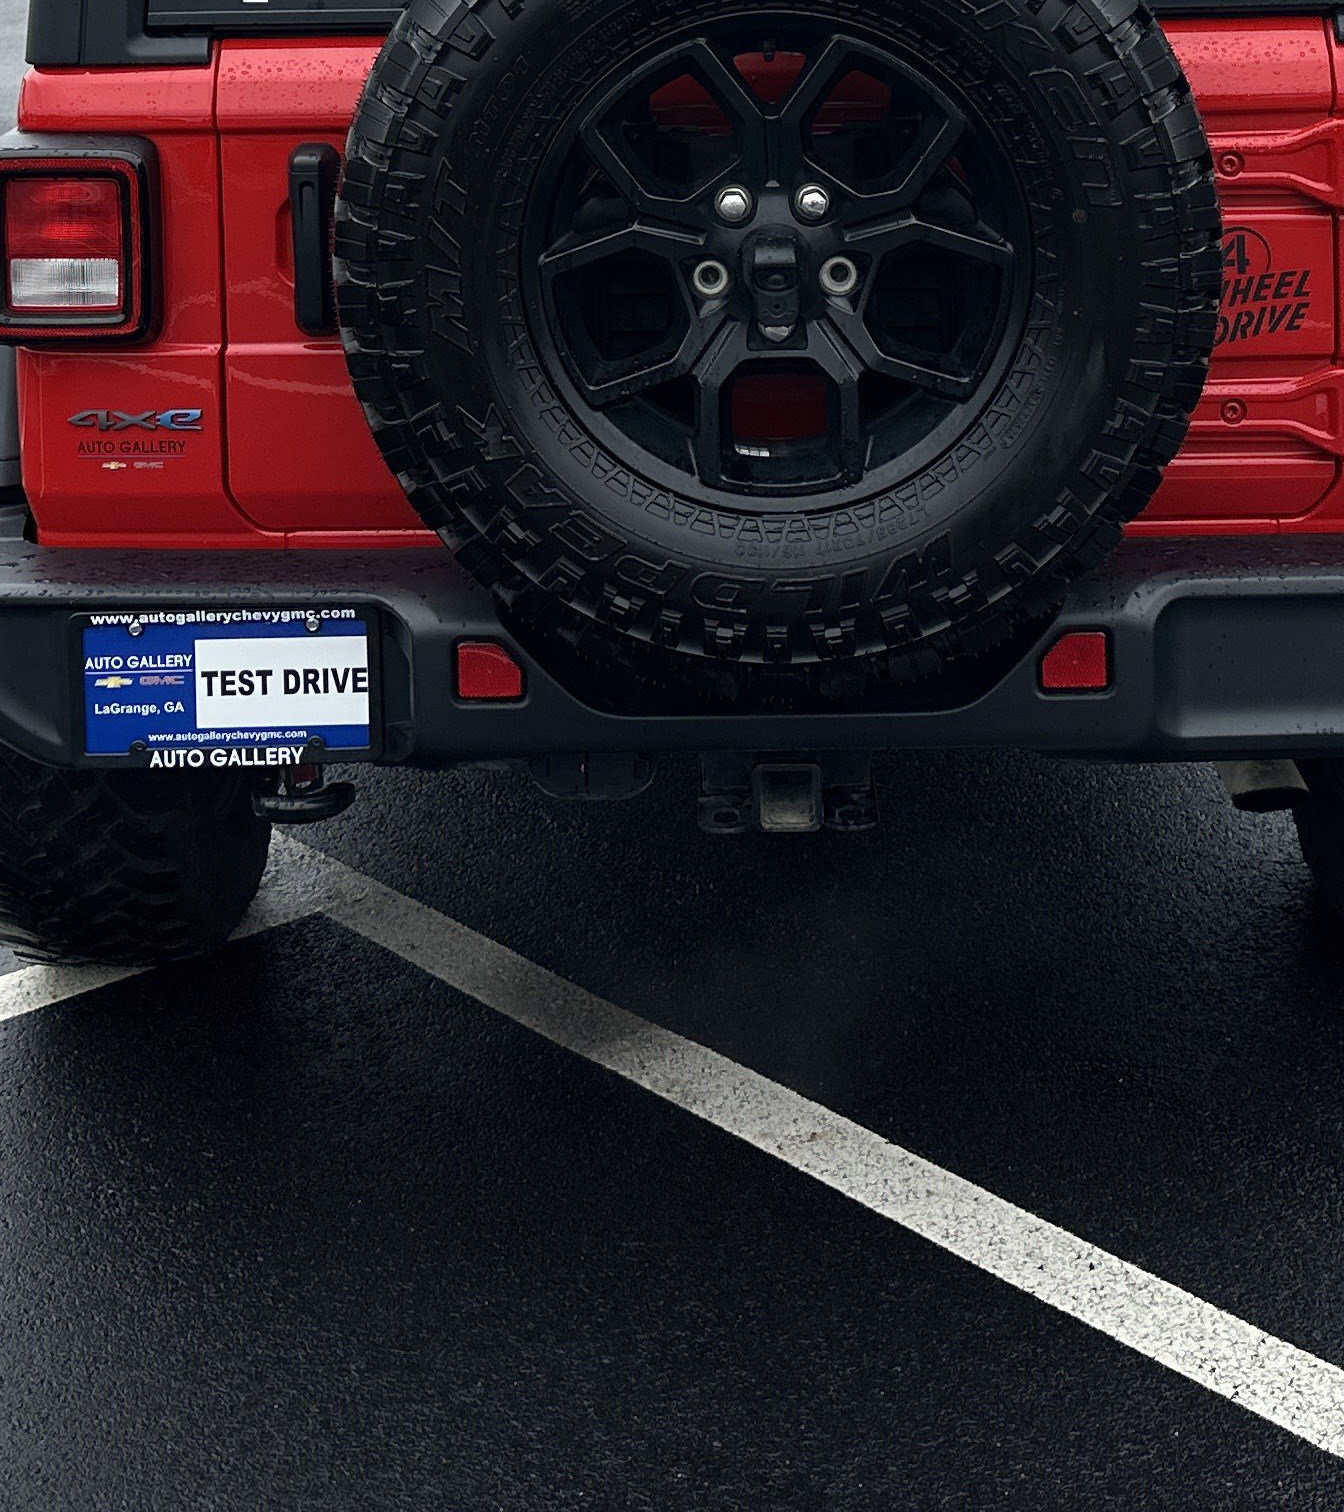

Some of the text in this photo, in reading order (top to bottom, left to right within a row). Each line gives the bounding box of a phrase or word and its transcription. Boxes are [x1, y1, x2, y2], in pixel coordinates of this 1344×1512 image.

[1222, 234, 1250, 275] 4
[1212, 302, 1311, 347] DRIVE
[78, 440, 186, 454] AUTO GALLERY
[90, 607, 356, 626] www.autogallerychevygmc.com
[85, 654, 193, 670] AUTO GALLERY
[139, 675, 185, 686] GMC
[201, 667, 368, 697] TEST DRIVE
[94, 701, 185, 716] LaGrange, GA
[148, 730, 307, 743] www.autogallerychevygmc.com
[149, 746, 304, 768] AUTO GALLERY
